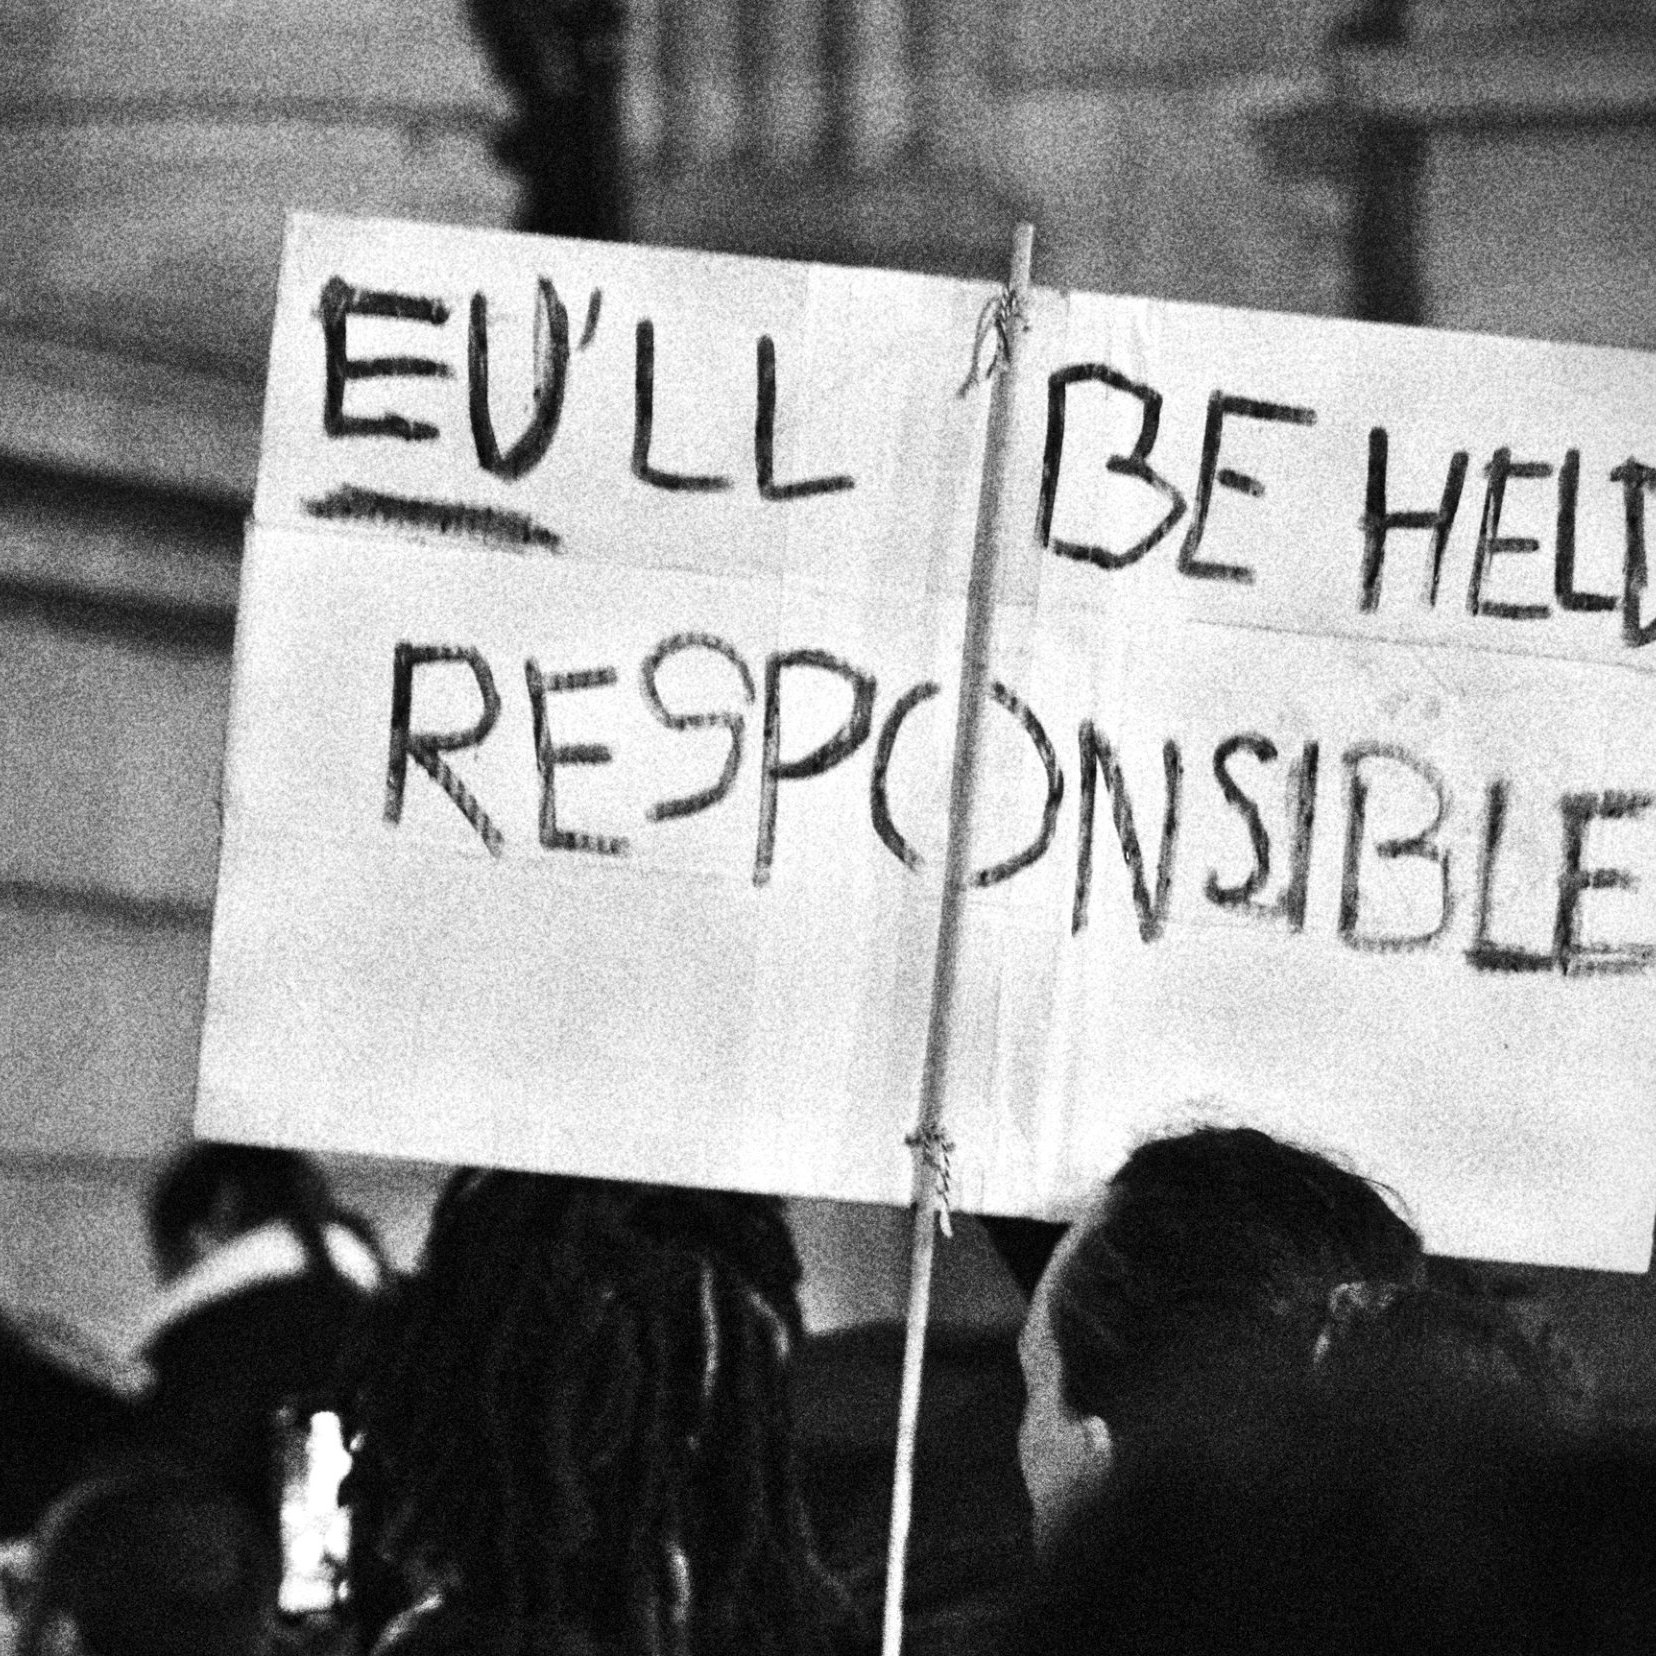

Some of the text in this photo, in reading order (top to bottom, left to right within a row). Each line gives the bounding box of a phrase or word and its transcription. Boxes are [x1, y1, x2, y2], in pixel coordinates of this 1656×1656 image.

[315, 275, 855, 500] EU'LL
[1035, 362, 1317, 584] BE
[383, 631, 1656, 976] RESPONSIBLE
